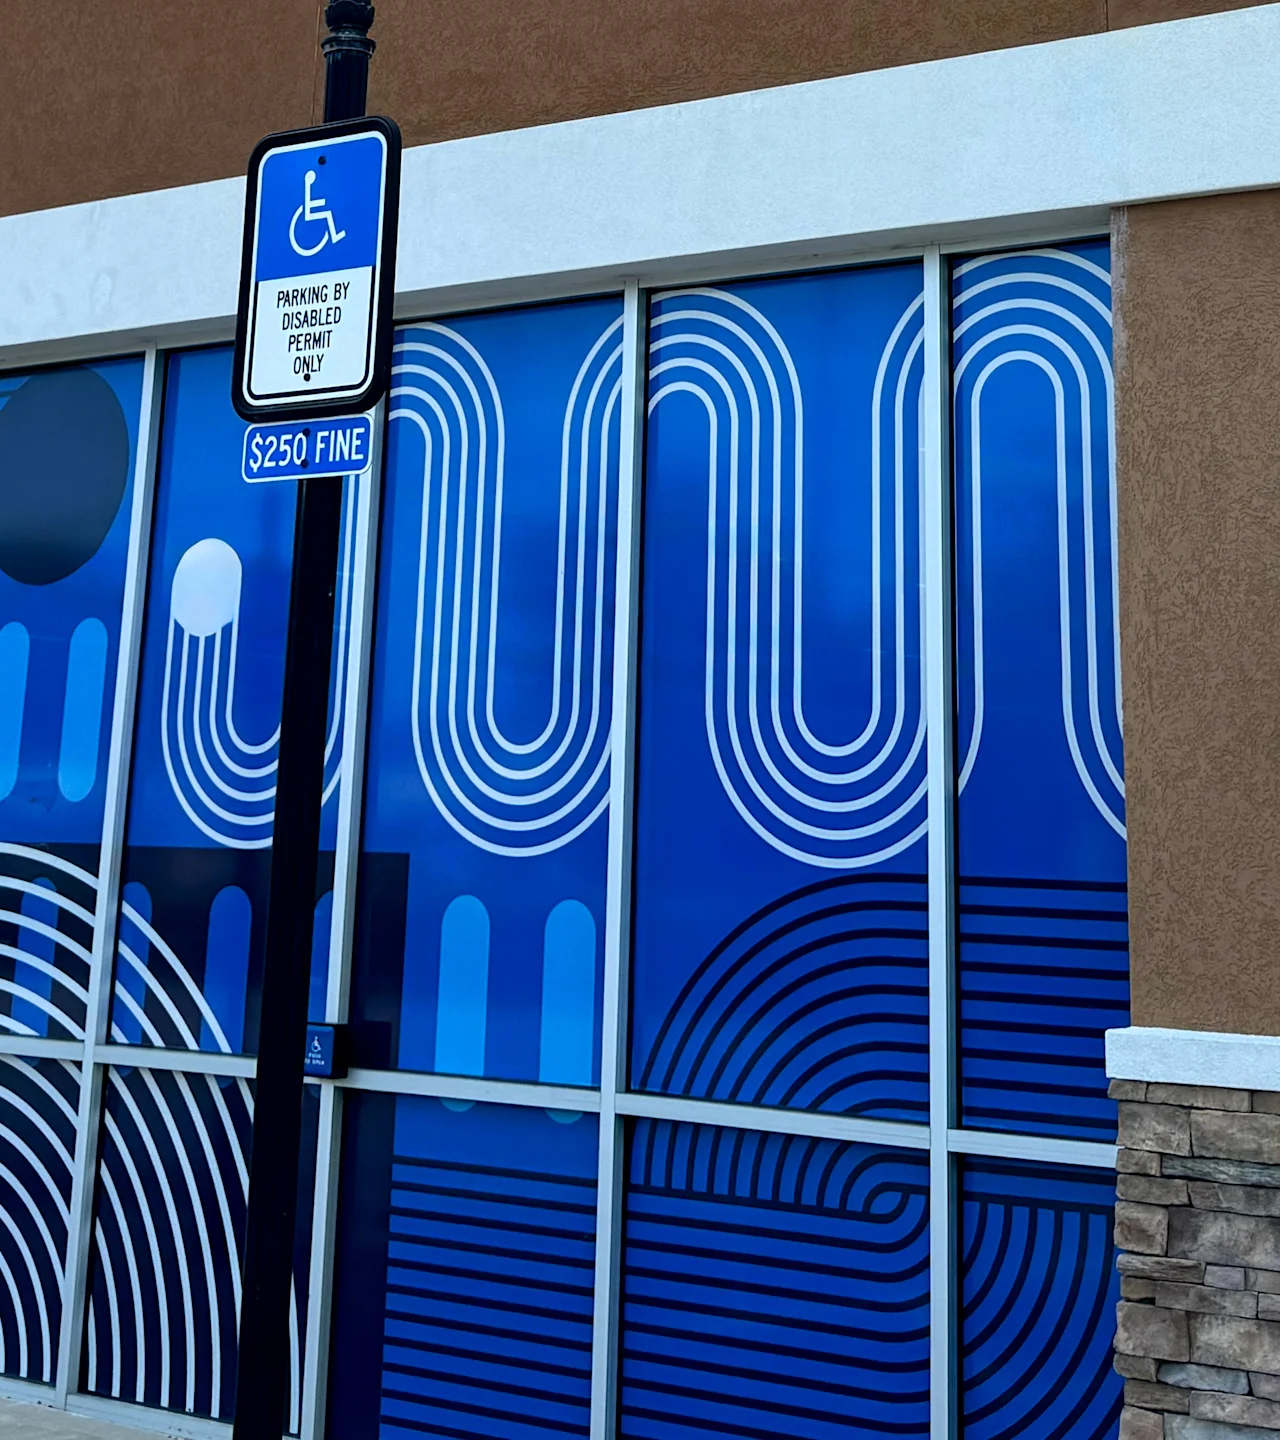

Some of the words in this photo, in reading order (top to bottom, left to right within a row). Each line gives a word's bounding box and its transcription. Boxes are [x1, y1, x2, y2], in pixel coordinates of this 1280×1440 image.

[276, 284, 328, 309] PARKING
[333, 281, 351, 301] BY
[282, 305, 342, 331] DISABLED
[287, 329, 333, 353] PERMIT
[293, 353, 325, 375] ONLY
[249, 432, 307, 473] $250
[314, 426, 366, 464] FINE
